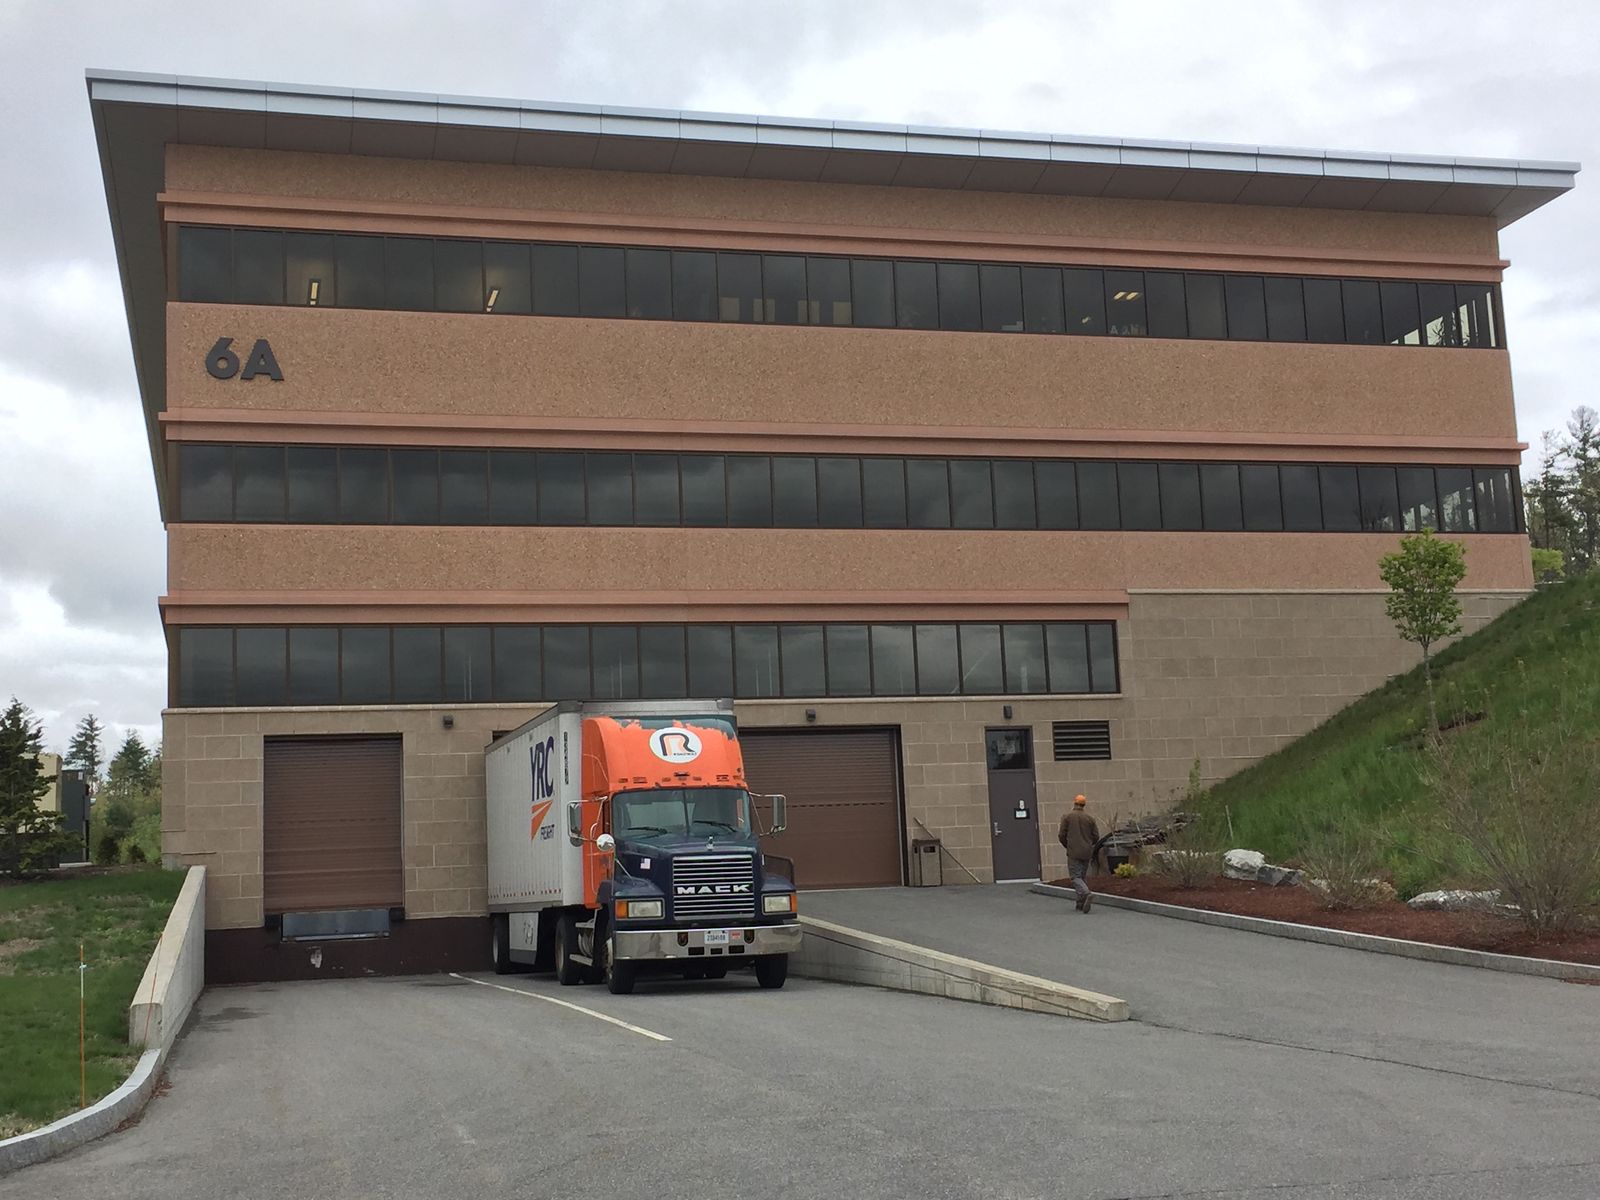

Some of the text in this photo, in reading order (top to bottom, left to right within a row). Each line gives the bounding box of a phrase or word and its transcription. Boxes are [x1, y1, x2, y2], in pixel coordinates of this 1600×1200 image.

[205, 337, 285, 381] 6A
[529, 736, 555, 801] YRC
[676, 884, 750, 895] MACK
